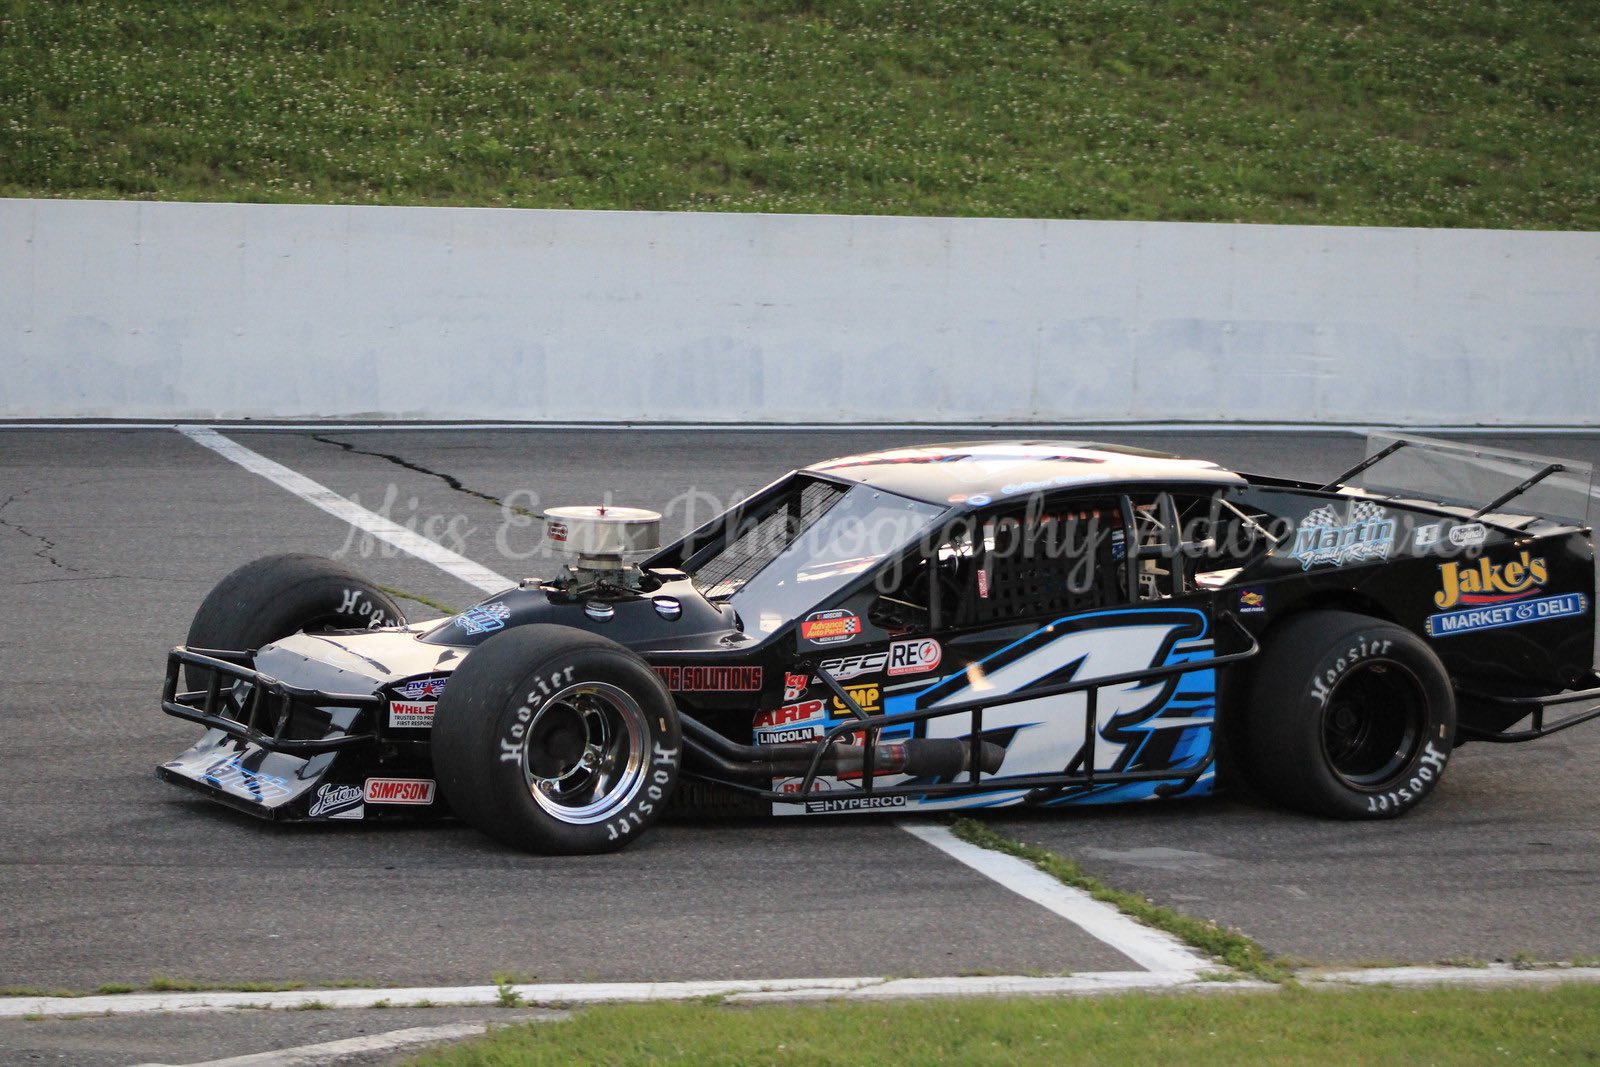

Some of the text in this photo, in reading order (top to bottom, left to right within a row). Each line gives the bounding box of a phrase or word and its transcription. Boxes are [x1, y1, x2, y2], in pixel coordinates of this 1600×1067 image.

[1292, 516, 1392, 555] Martin
[1299, 540, 1389, 570] Family Racing
[1434, 551, 1548, 609] Jake's
[810, 621, 844, 631] Advance
[1442, 597, 1574, 631] MARKET & DELI
[892, 643, 918, 667] RE
[682, 666, 762, 691] SOLUTIONS
[1311, 636, 1392, 706] Hoosier
[406, 682, 428, 691] FIVE
[392, 703, 437, 715] WHELE
[500, 665, 575, 767] Hoosier
[753, 700, 822, 728] ARP
[761, 729, 812, 744] LINCOLN
[369, 782, 430, 800] SIMPSON
[607, 742, 677, 840] Hoosier
[1367, 741, 1446, 812] Hoosier
[309, 783, 363, 816] Jostens
[825, 796, 904, 811] HYPERCO
